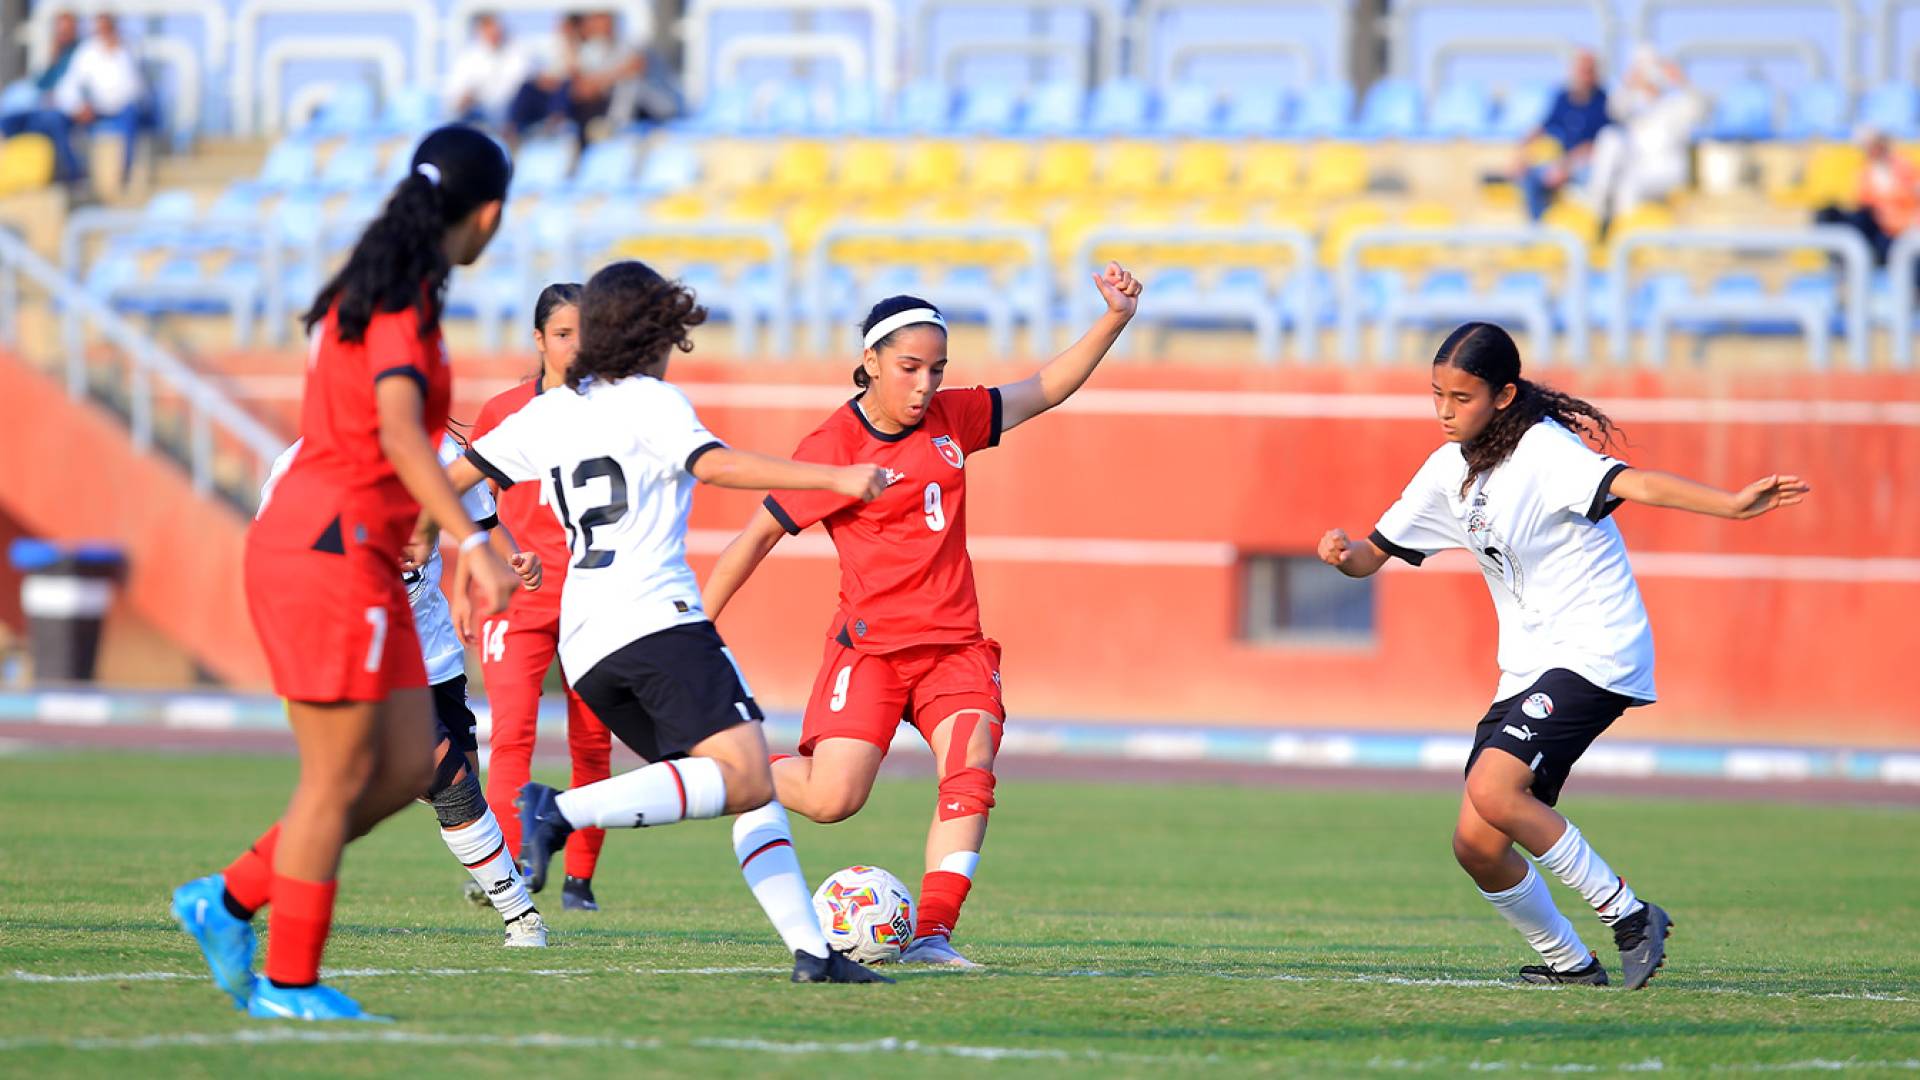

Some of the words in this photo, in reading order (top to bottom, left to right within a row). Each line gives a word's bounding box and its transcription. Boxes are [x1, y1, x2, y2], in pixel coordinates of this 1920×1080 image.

[550, 455, 628, 568] 12
[924, 482, 945, 532] 9
[483, 620, 509, 663] 14
[830, 665, 852, 712] 9
